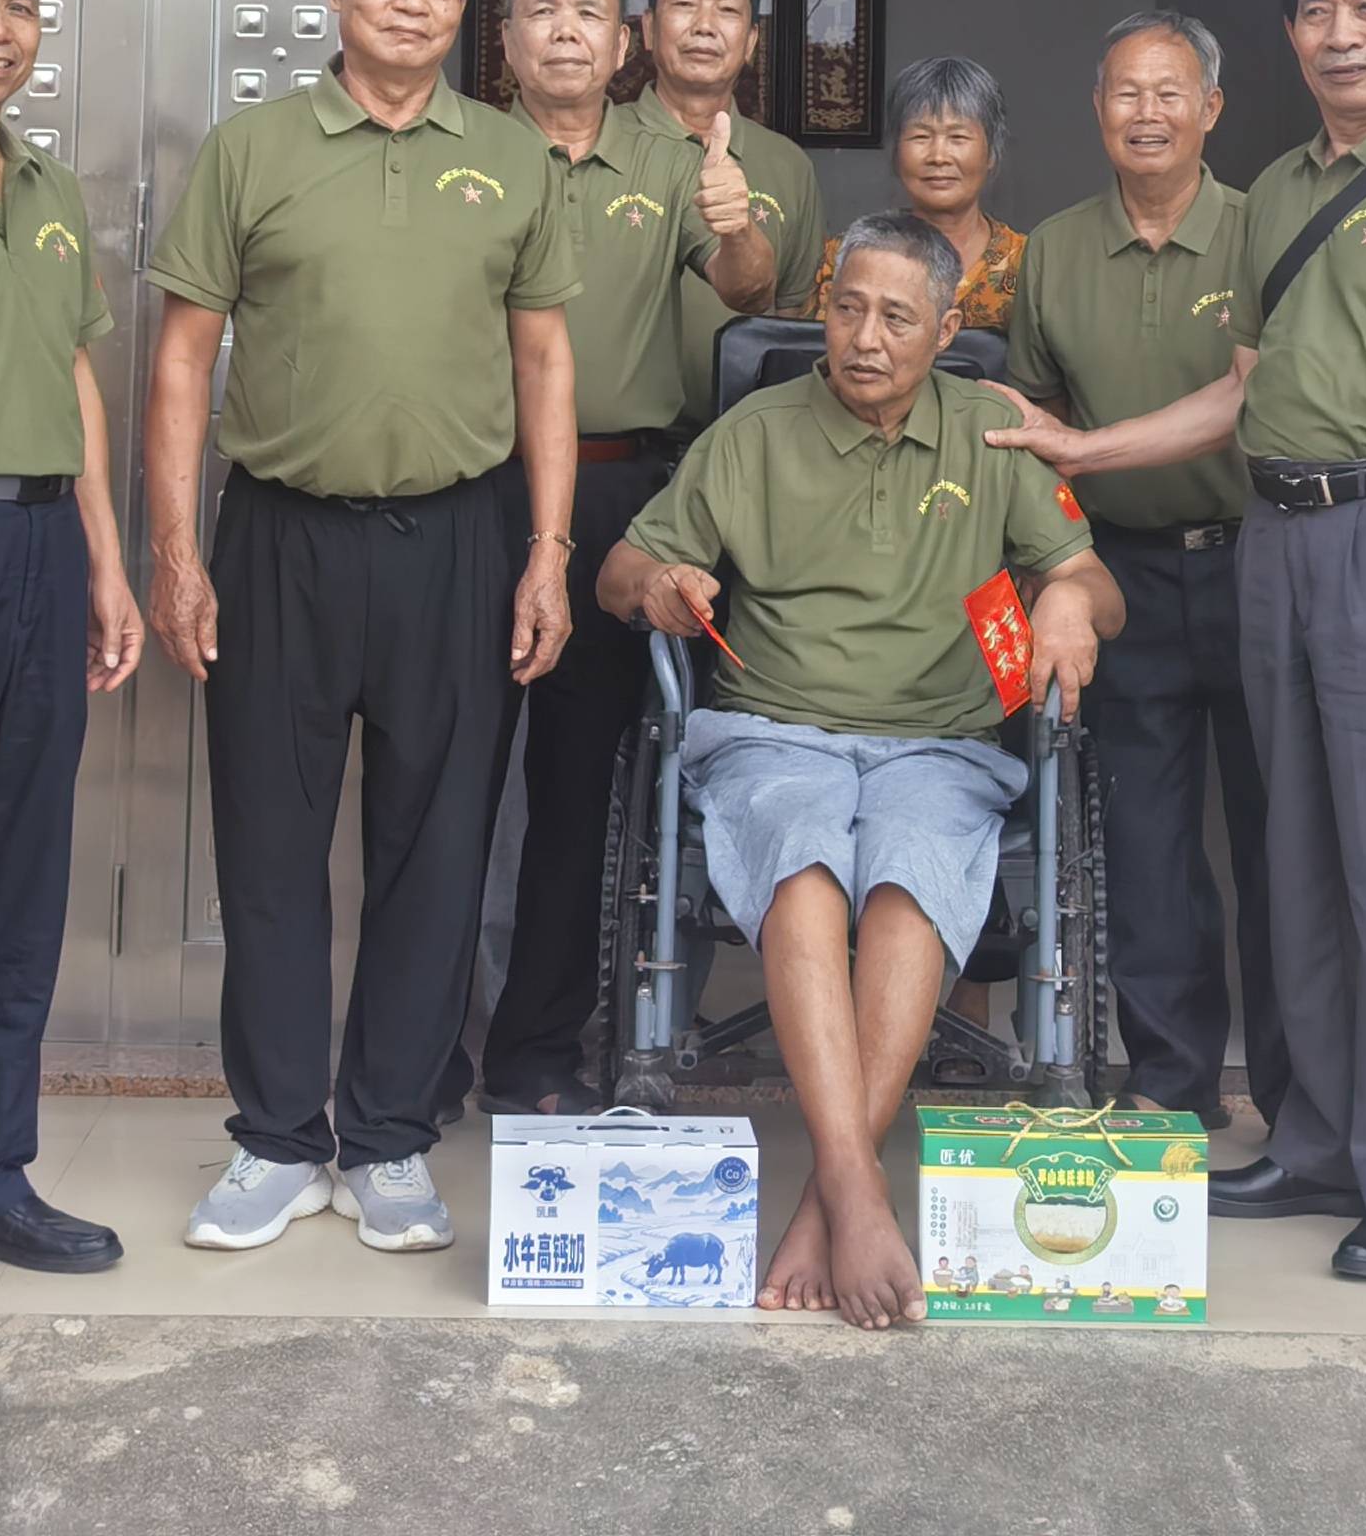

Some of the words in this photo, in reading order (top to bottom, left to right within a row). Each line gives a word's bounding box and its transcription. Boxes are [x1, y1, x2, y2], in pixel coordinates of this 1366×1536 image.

[503, 1231, 586, 1274] 水牛高钙奶
